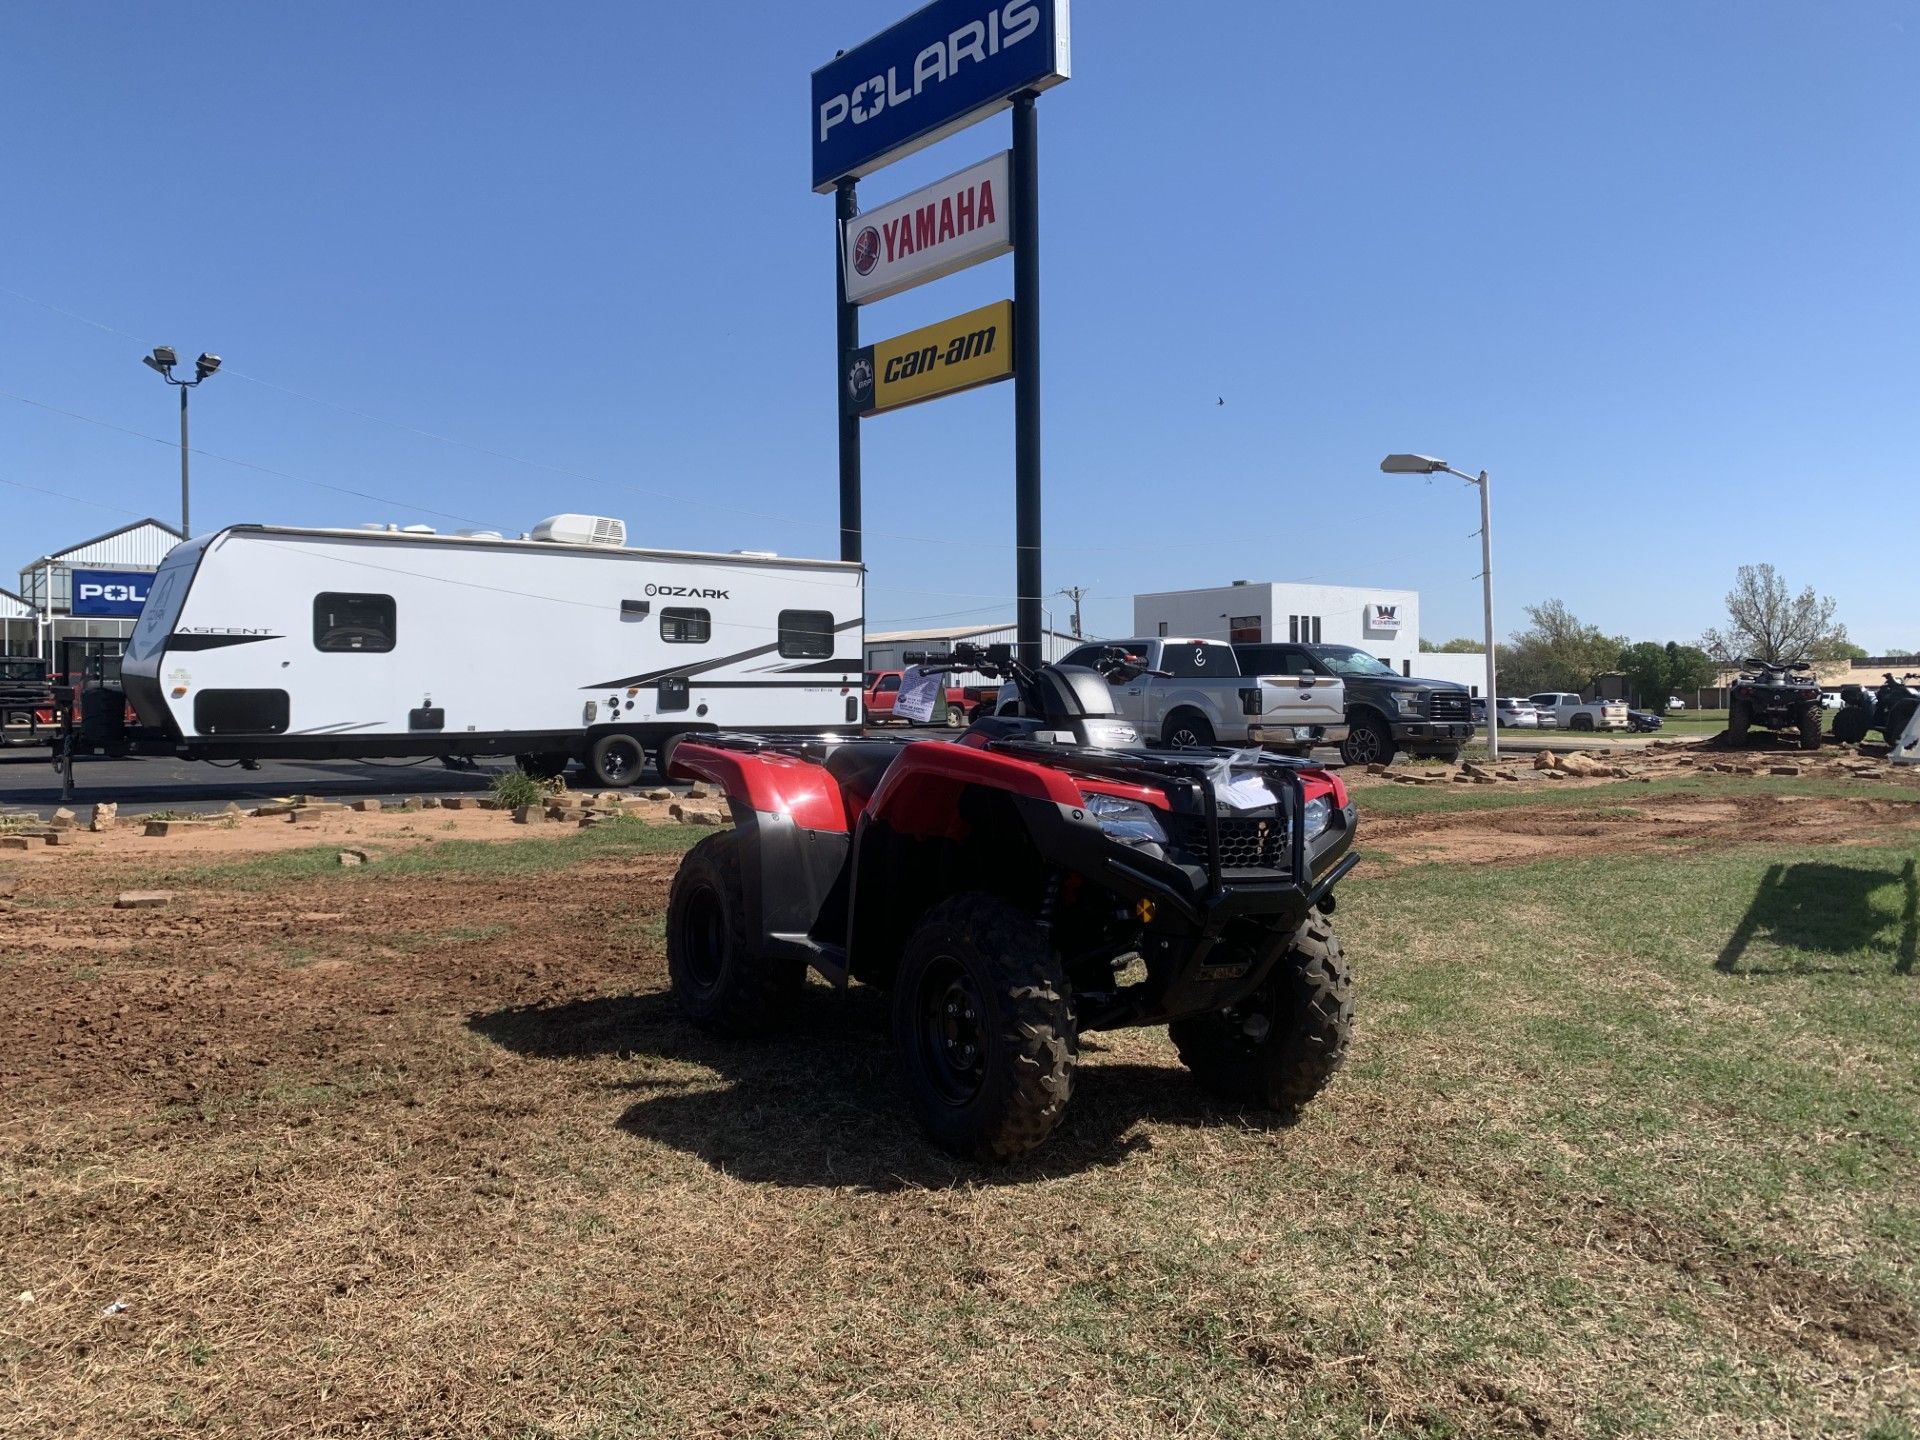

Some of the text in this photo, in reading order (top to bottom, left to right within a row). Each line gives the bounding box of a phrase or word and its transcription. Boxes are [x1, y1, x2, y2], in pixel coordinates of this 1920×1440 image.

[820, 0, 1040, 143] POLARIS
[882, 179, 996, 264] YAMAHA
[883, 325, 997, 384] can-am
[80, 584, 150, 602] POL
[658, 585, 730, 600] OZARK
[178, 626, 273, 635] ASCENT
